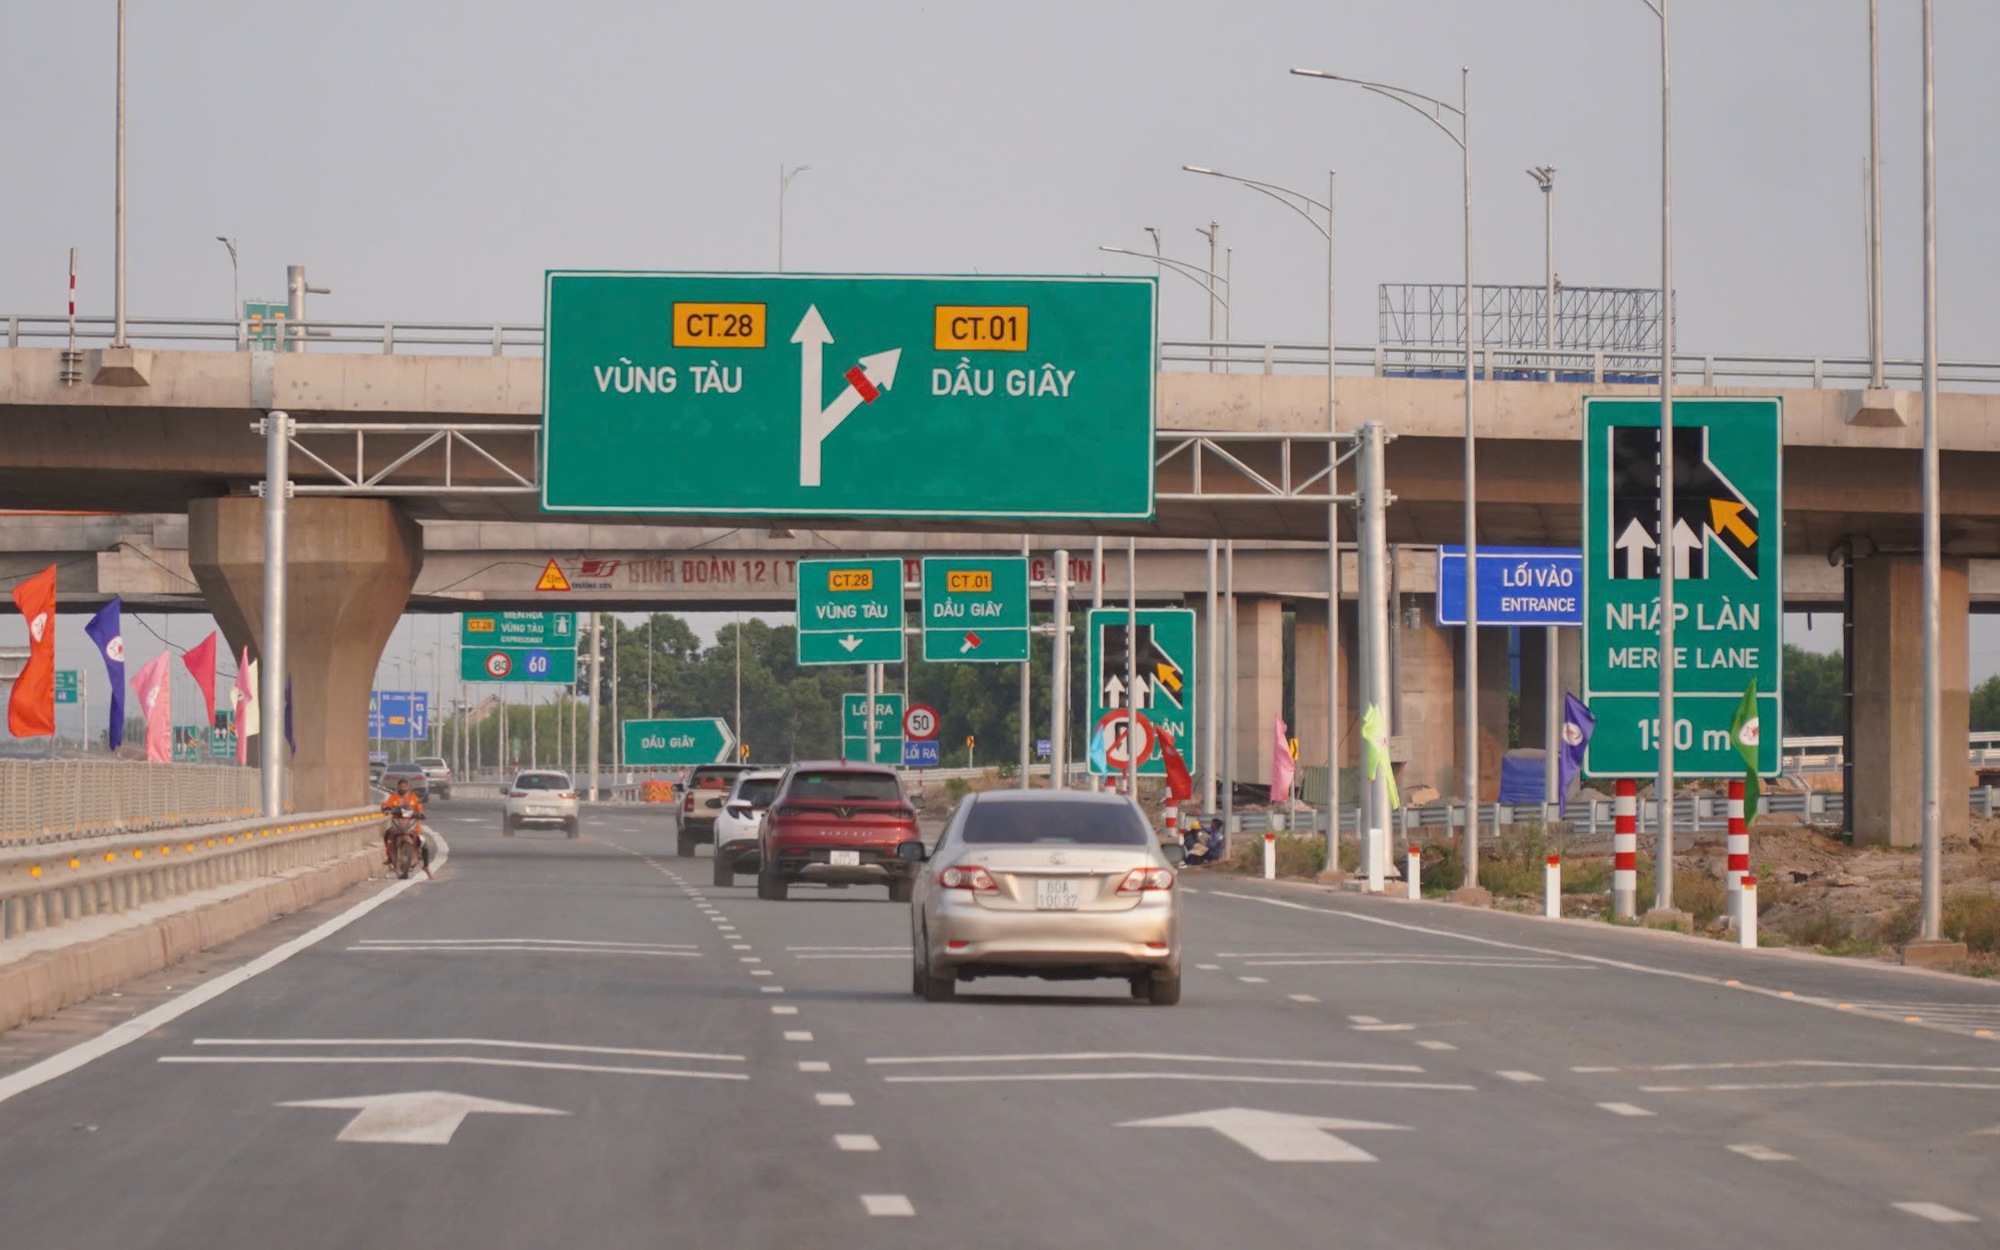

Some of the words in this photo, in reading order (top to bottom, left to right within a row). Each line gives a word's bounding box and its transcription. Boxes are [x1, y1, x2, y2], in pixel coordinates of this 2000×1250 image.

[686, 314, 753, 337] CT.28
[951, 315, 1017, 342] CT.01
[594, 357, 676, 393] VŨNG
[689, 361, 742, 393] TÀU
[932, 357, 994, 396] DẦU
[1006, 363, 1075, 397] GIÂY
[682, 556, 736, 584] ĐOÀN
[743, 560, 766, 582] 12
[1503, 562, 1533, 587] LỐI
[1535, 563, 1573, 588] VÀO
[832, 574, 870, 588] CT.28
[951, 574, 989, 588] CT.01
[816, 602, 857, 619] VŨNG
[862, 600, 888, 619] TÀU
[933, 597, 964, 618] DẦU
[970, 600, 1003, 617] GIÂY
[1502, 597, 1576, 612] ENTRANCE
[1606, 597, 1689, 636] NHẬP
[1697, 596, 1760, 631] LÀN
[501, 622, 525, 633] VŨNG
[527, 622, 544, 633] TÀU
[529, 656, 547, 673] 60
[1608, 647, 1688, 669] MERE
[1696, 647, 1760, 669] LANE
[852, 701, 869, 716] LỐ
[875, 704, 894, 716] RA
[912, 715, 929, 731] 50
[1702, 730, 1731, 751] m
[905, 744, 919, 759] LỐI
[923, 748, 937, 759] RA
